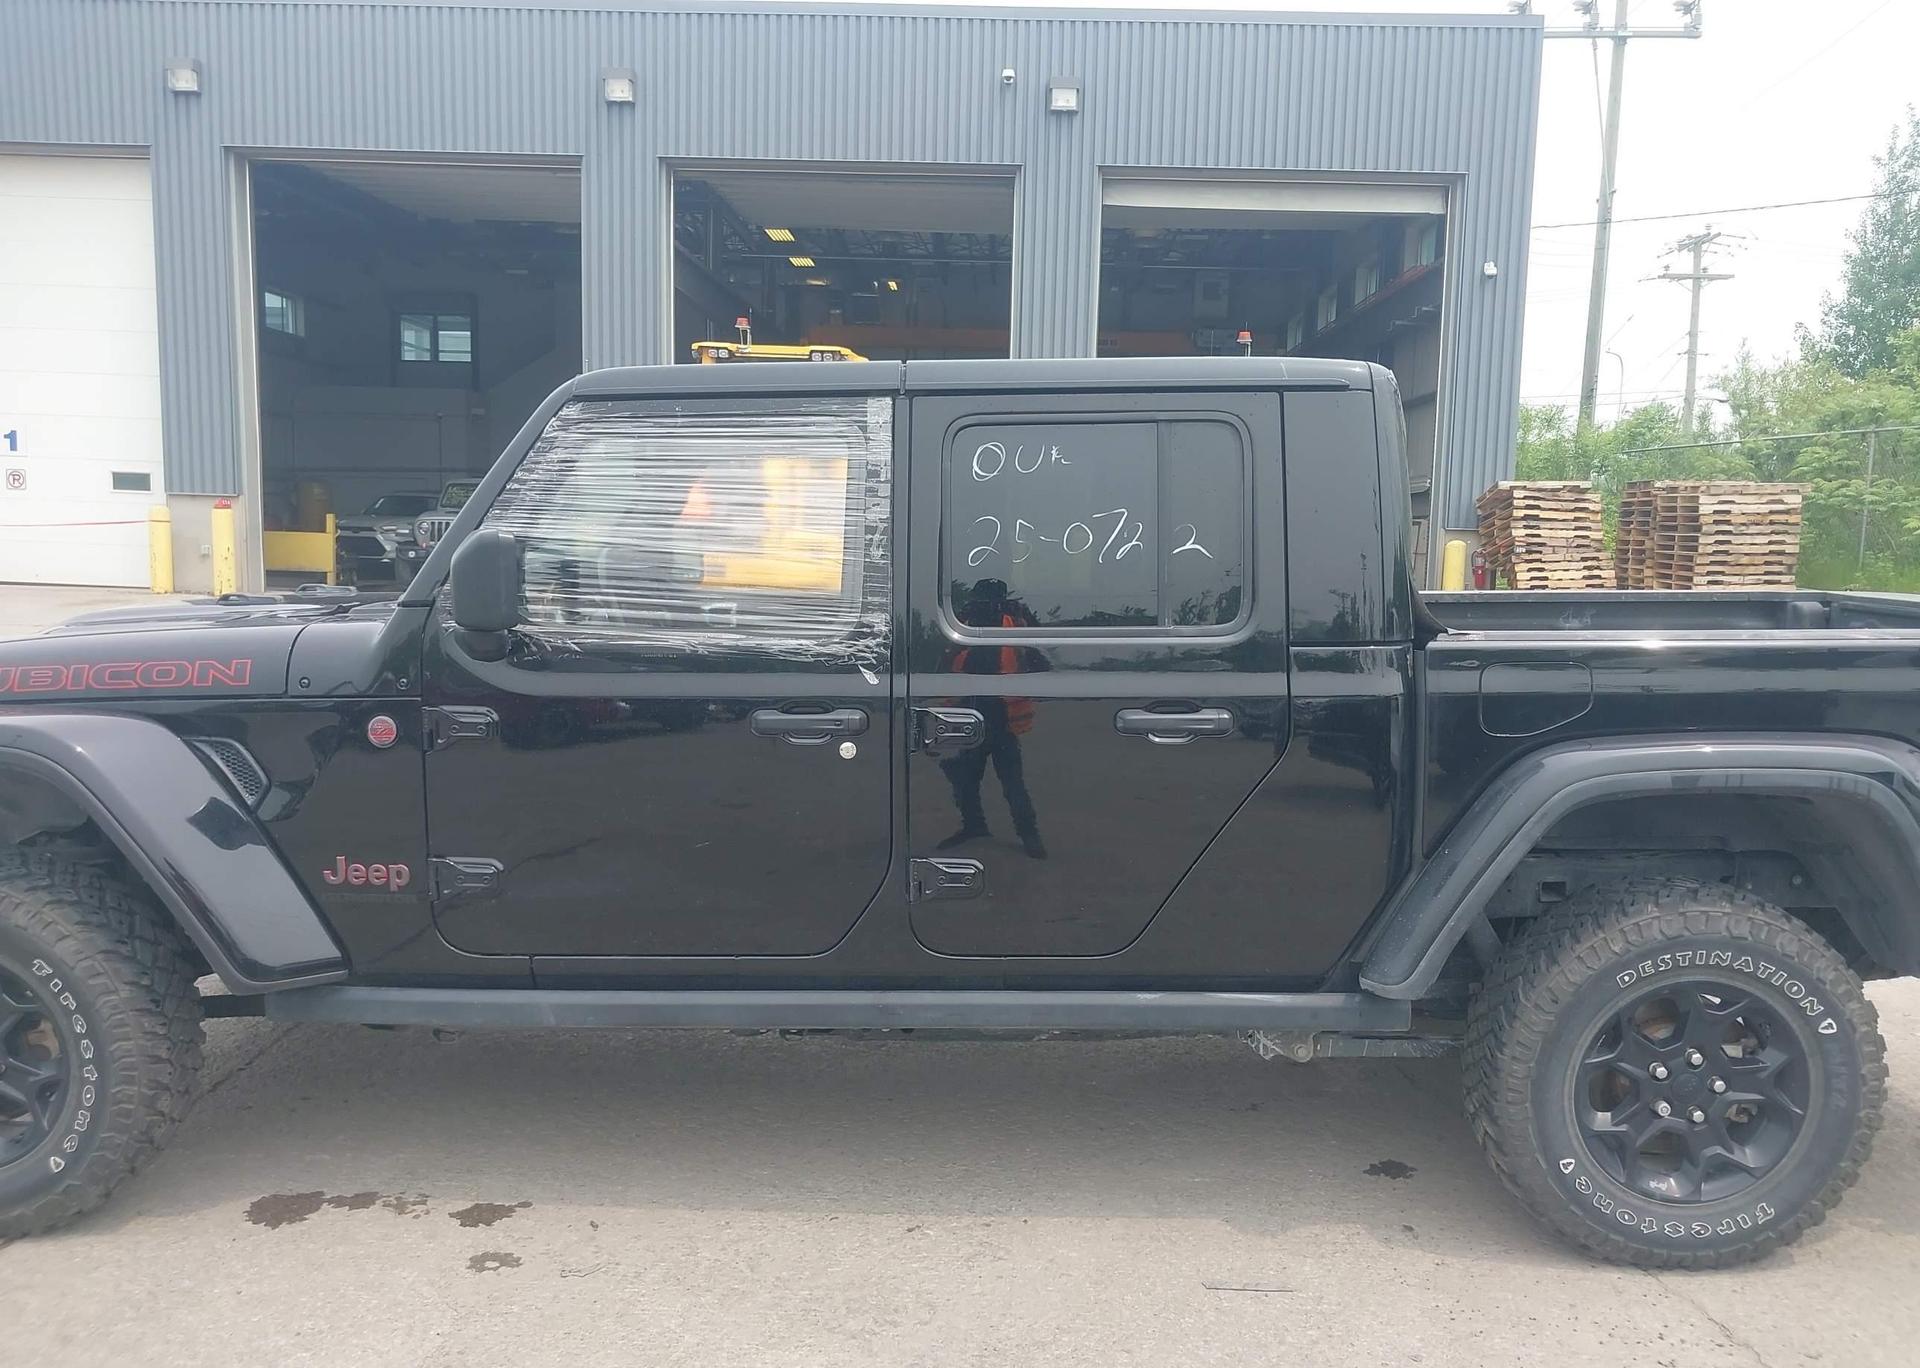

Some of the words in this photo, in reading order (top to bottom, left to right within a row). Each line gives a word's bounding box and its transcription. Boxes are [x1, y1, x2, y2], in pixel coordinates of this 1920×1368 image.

[4, 430, 17, 451] 1
[0, 659, 251, 692] BICON
[322, 855, 410, 891] Jeep
[1616, 950, 1823, 1017] DESTINATION
